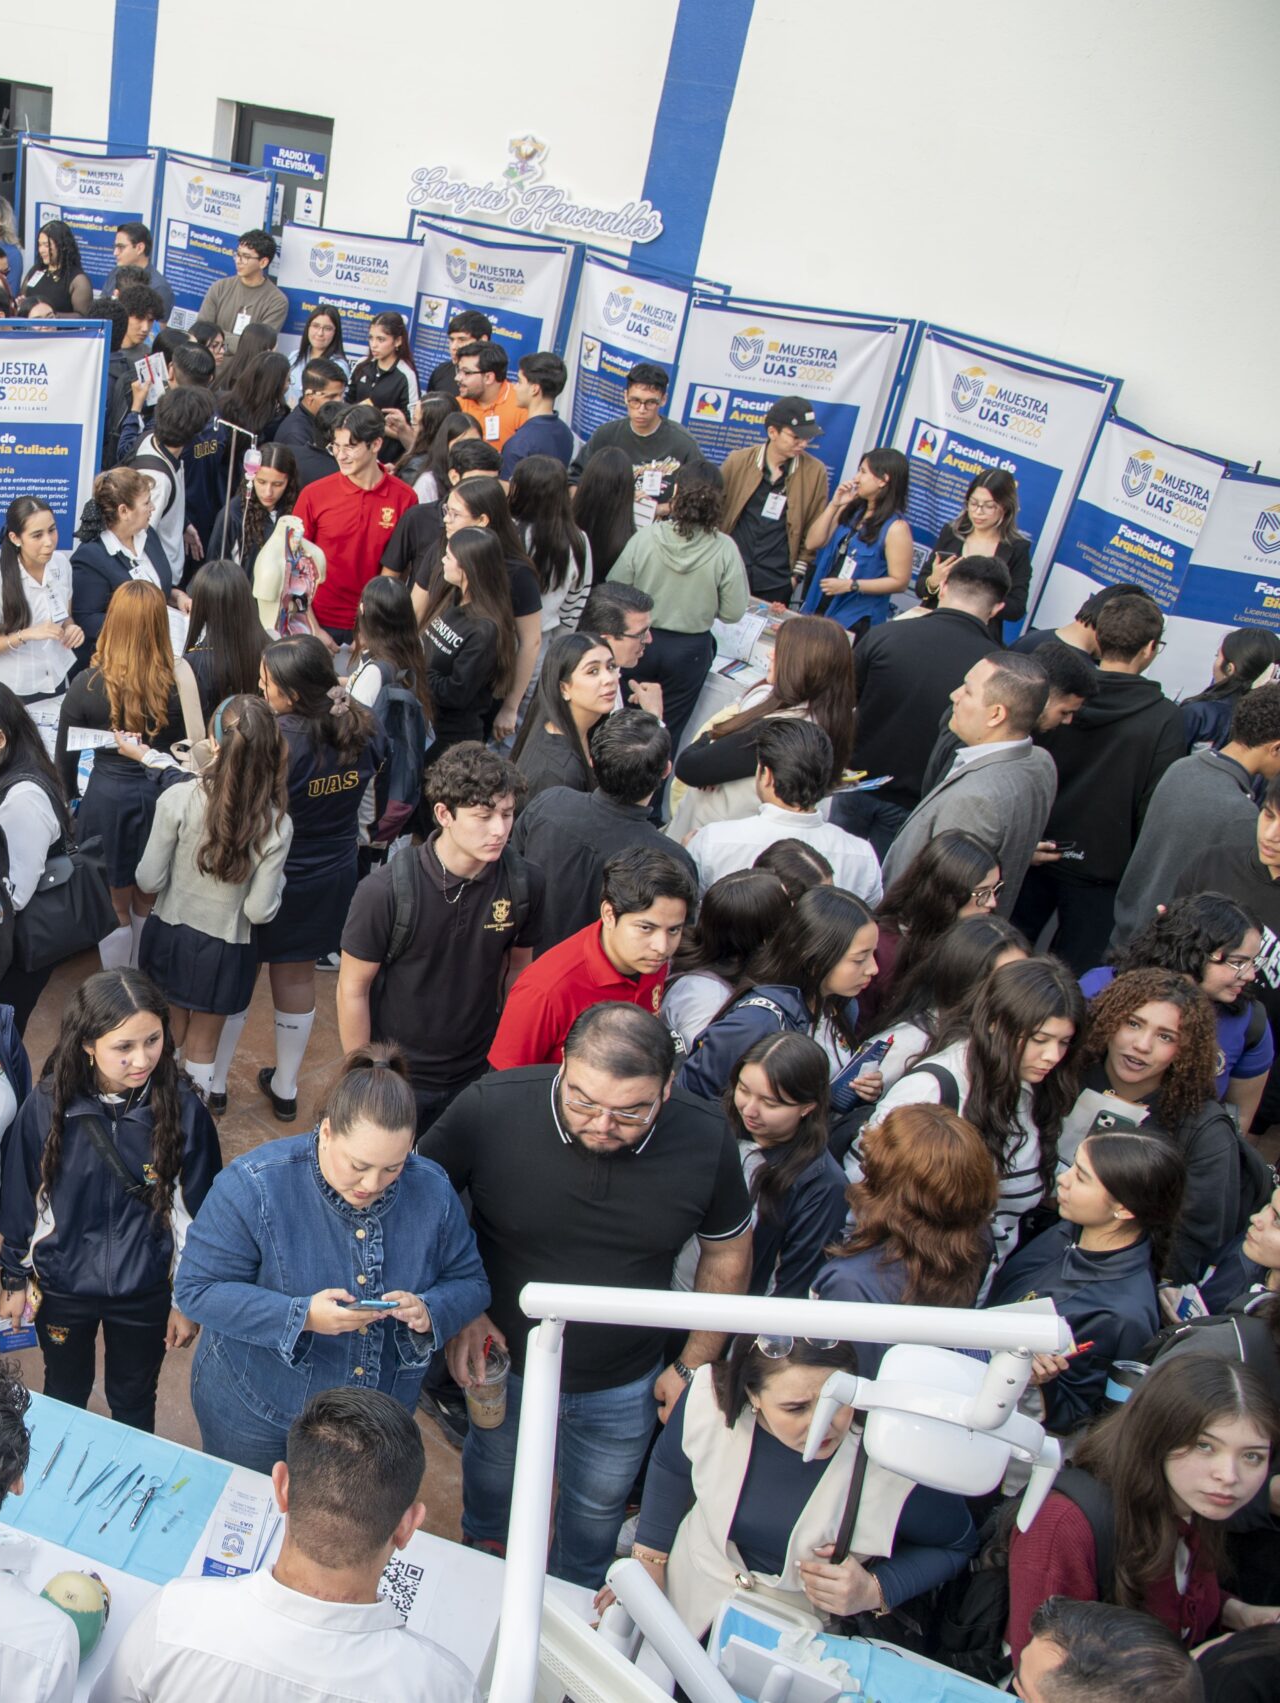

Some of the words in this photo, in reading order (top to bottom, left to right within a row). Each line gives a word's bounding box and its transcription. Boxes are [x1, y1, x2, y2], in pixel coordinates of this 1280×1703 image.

[279, 148, 304, 161] RADIO
[272, 157, 316, 172] TELEVISIÓN
[86, 170, 124, 181] MUESTRA
[79, 185, 100, 195] UAS
[211, 188, 240, 202] MUESTRA
[203, 204, 221, 216] UAS
[407, 167, 510, 214] Energías
[510, 186, 659, 239] Renovables
[346, 254, 389, 269] MUESTRA
[335, 270, 360, 282] UAS
[477, 263, 524, 278] MUESTRA
[469, 278, 494, 292] UAS
[359, 302, 371, 312] de
[641, 304, 677, 323] MUESTRA
[626, 320, 650, 337] UAS
[778, 343, 838, 361] MUESTRA
[765, 354, 837, 369] PROFESIOGRÁFICA
[763, 363, 797, 378] UAS
[798, 366, 834, 383] 2026
[8, 386, 48, 401] 2026
[995, 388, 1048, 415] MUESTRA
[982, 397, 1046, 424] PROFESIOGRÁFICA
[978, 406, 1009, 427] UAS
[1009, 416, 1042, 440] 2026
[0, 433, 16, 444] de
[15, 444, 68, 456] Culiacán
[194, 440, 217, 458] UAS
[947, 439, 1000, 467] Facultad
[1000, 460, 1016, 474] de
[1161, 473, 1210, 502] MUESTRA
[1146, 492, 1174, 514] UAS
[1173, 503, 1204, 528] 2026
[1118, 524, 1162, 551] Facultad
[1160, 545, 1175, 558] de
[1110, 535, 1174, 571] Arquitectura
[308, 770, 359, 797] UAS
